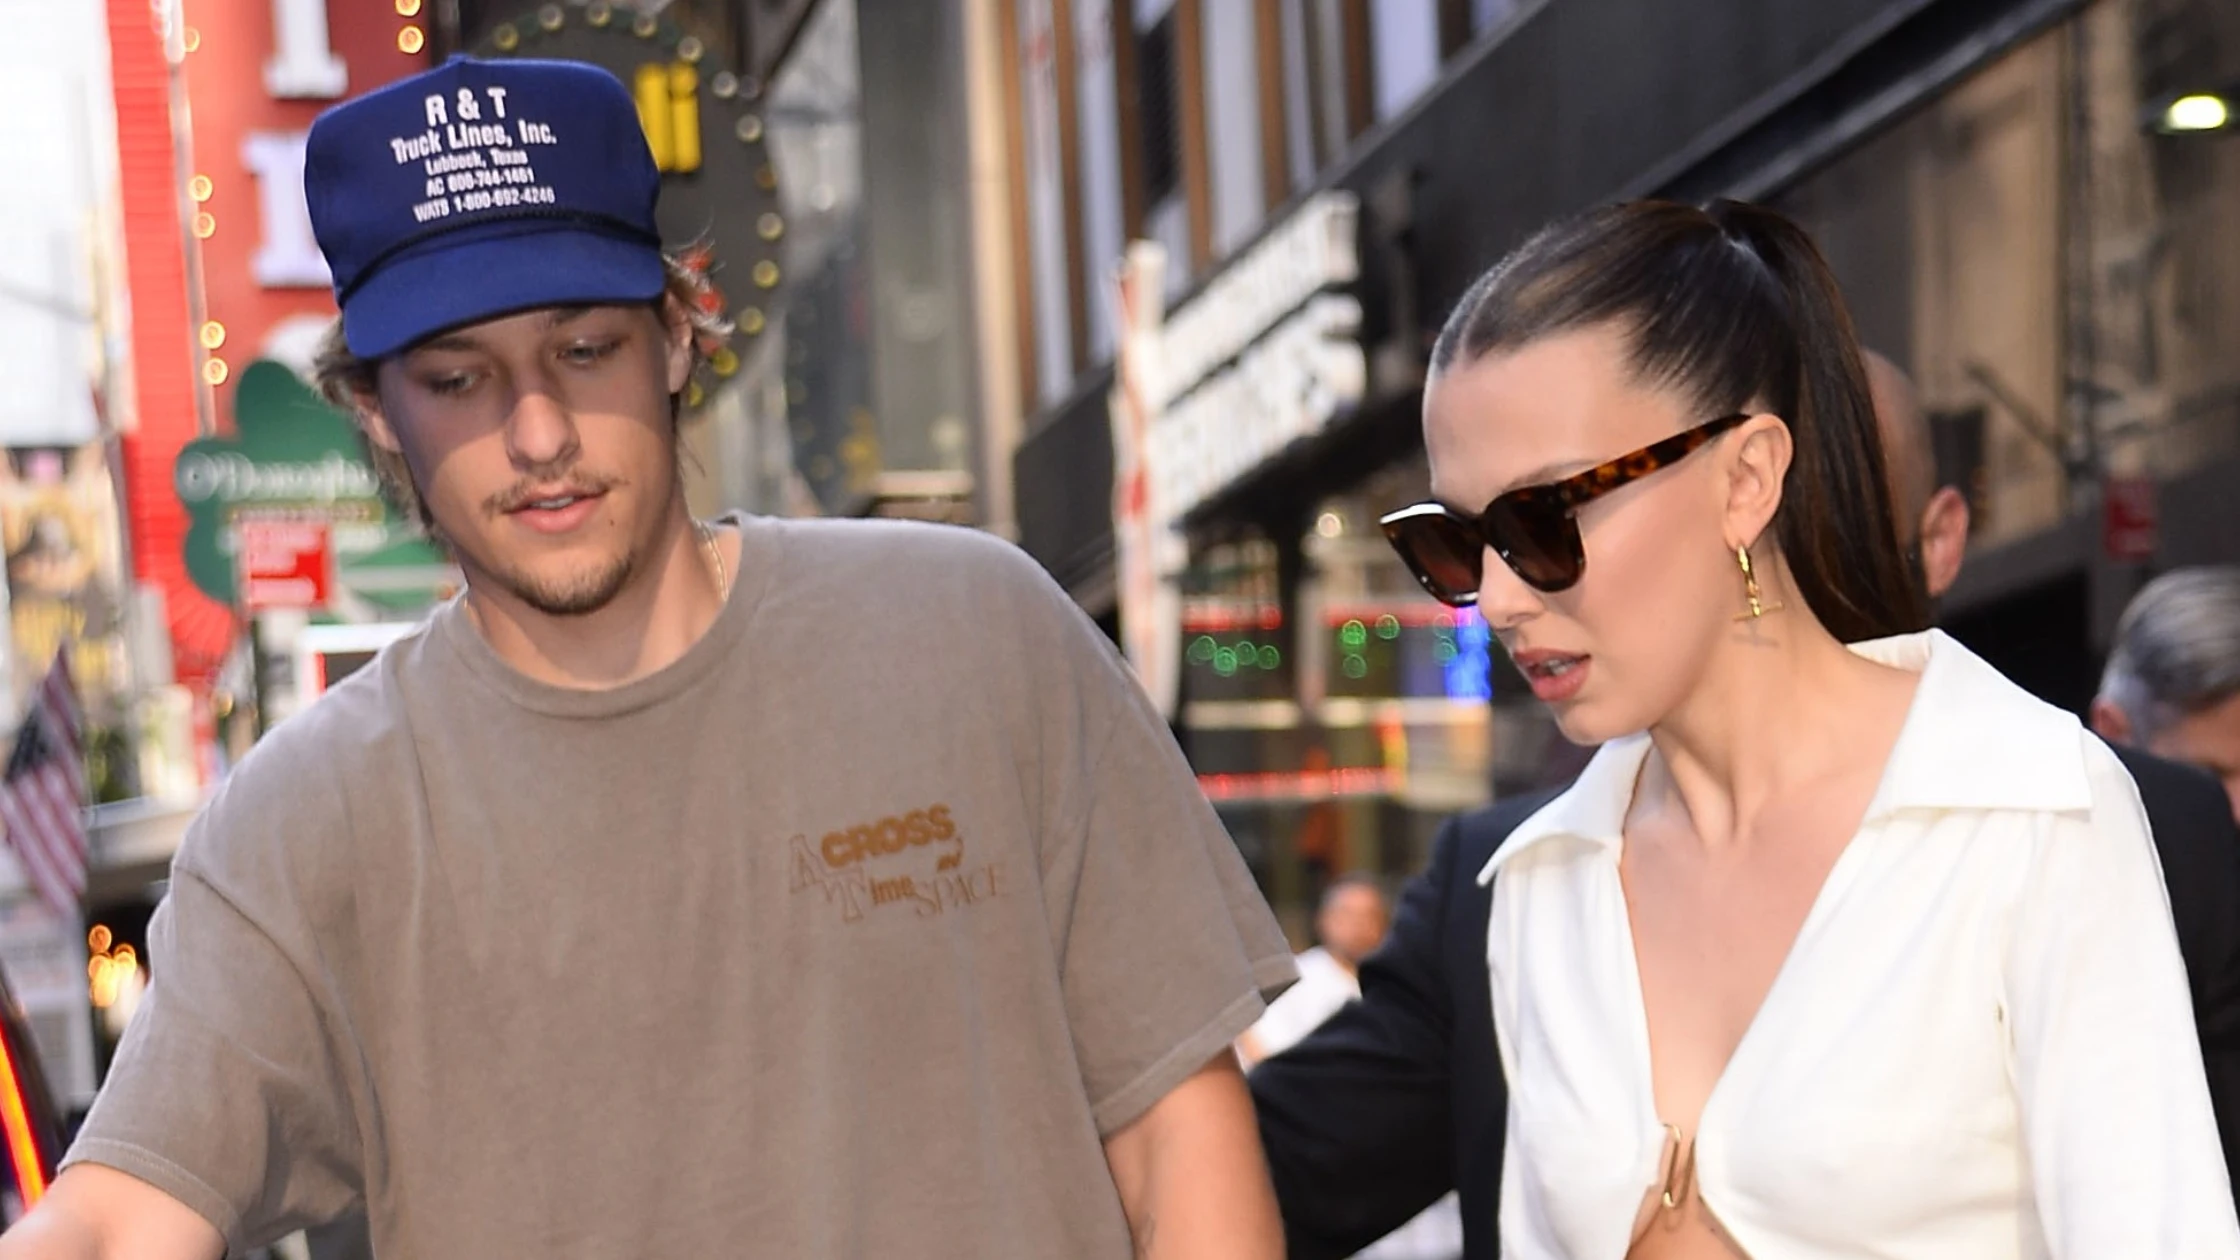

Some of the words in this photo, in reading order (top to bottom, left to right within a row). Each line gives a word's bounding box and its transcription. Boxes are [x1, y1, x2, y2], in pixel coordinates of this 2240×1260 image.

[425, 95, 448, 127] R
[457, 88, 481, 120] &
[486, 87, 507, 118] T
[391, 128, 442, 164] Truck
[447, 121, 513, 149] Lines,
[518, 119, 558, 146] Inc.
[426, 151, 487, 176] Lubbock,
[490, 148, 529, 168] Texas
[426, 179, 445, 198] AC
